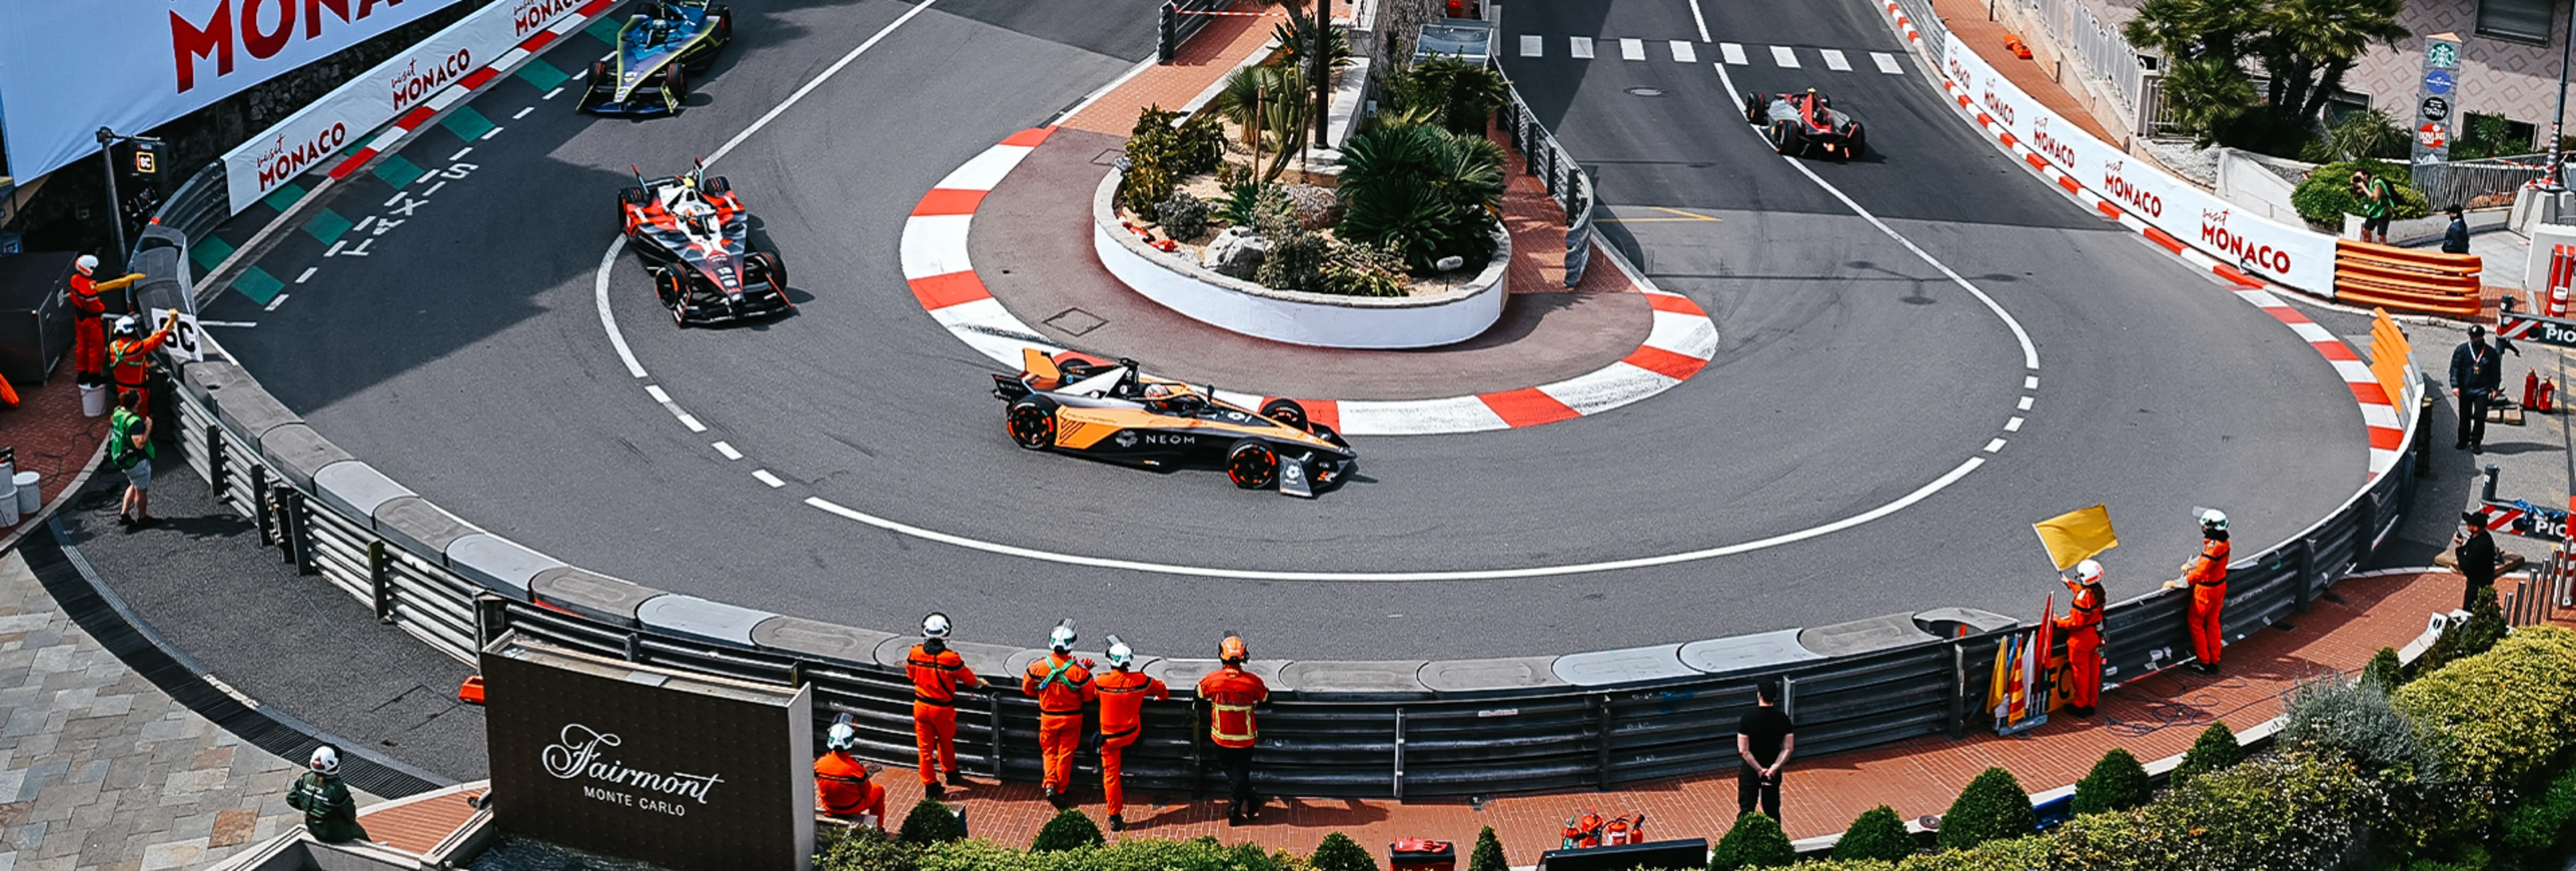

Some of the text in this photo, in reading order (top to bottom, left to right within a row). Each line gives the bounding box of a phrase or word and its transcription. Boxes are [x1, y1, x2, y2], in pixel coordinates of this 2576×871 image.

[391, 57, 417, 88] visit
[393, 48, 470, 111] MONACO
[1984, 89, 2015, 125] MONACO
[257, 134, 285, 168] visit
[259, 122, 345, 192] MONACO
[2034, 127, 2075, 168] MONACO
[2104, 172, 2161, 218] MONACO
[2202, 207, 2231, 226] visit
[2201, 219, 2291, 274] MONACO
[1146, 435, 1195, 444] NEOM
[542, 723, 725, 804] Fairmont
[583, 785, 685, 817] MONTE CARLO
